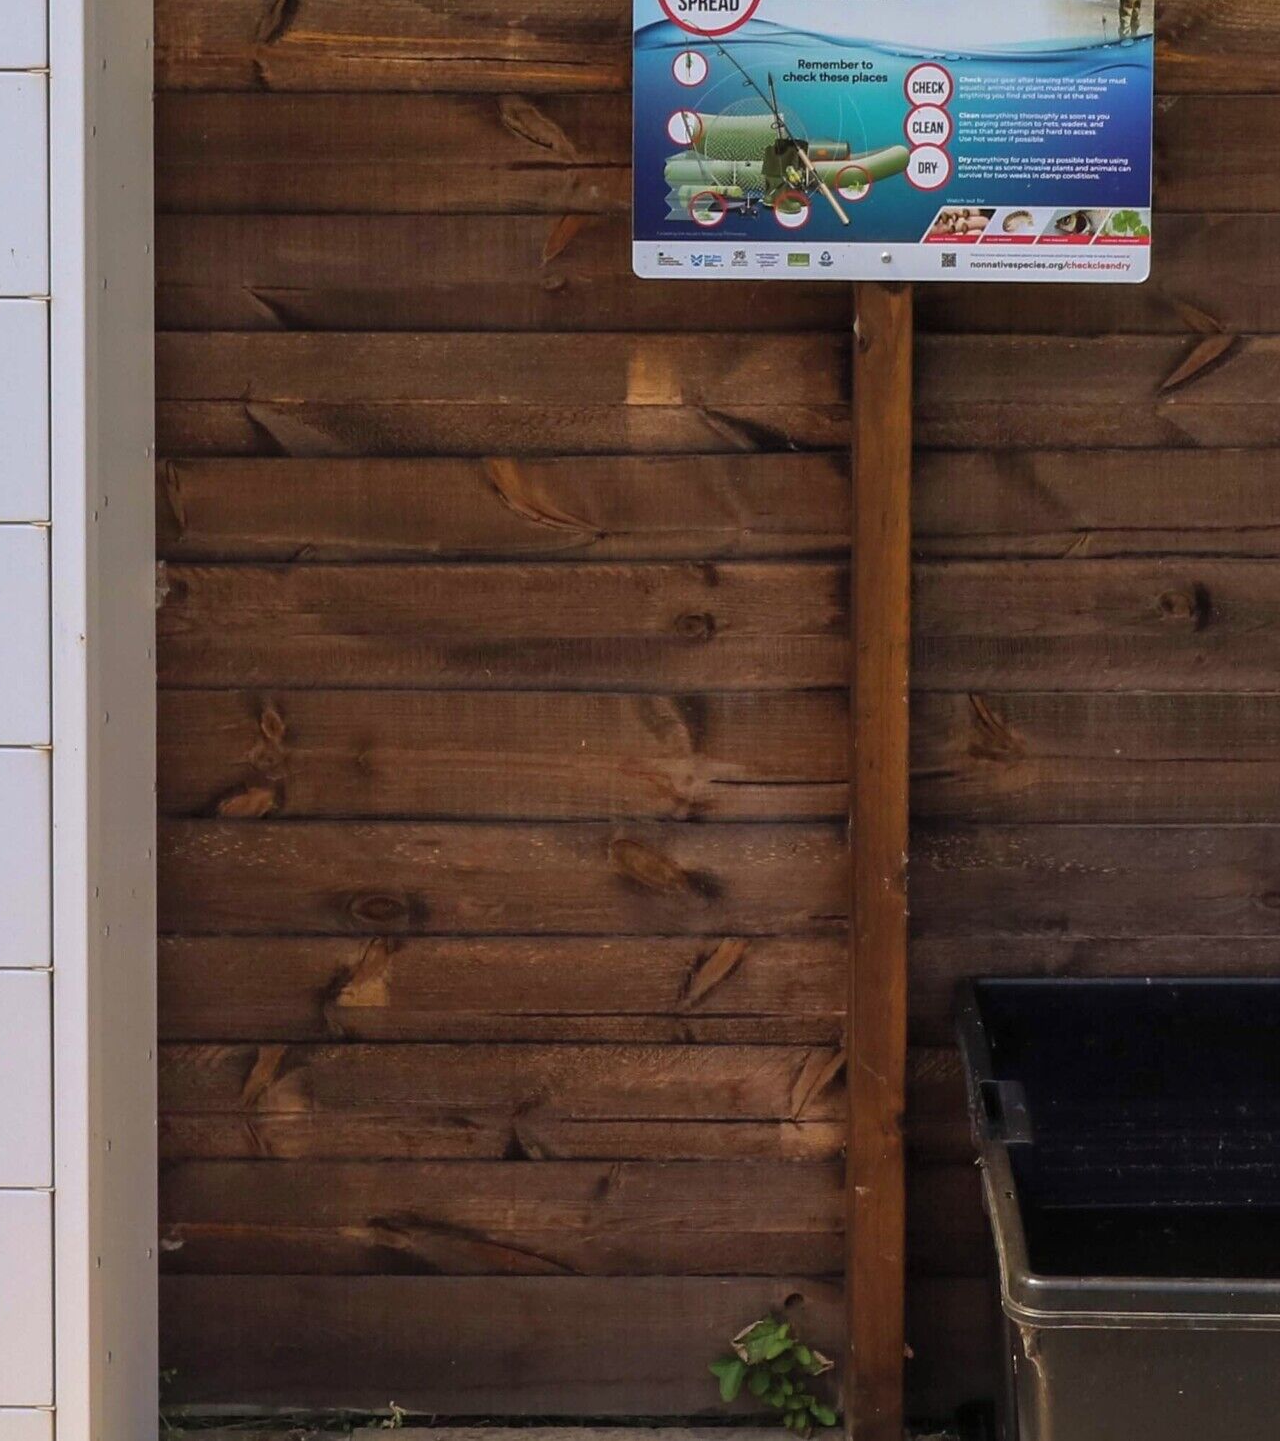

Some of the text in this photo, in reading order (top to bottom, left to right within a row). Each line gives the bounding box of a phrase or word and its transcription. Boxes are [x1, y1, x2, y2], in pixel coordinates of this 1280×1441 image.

[798, 59, 873, 70] Remember to
[783, 71, 887, 84] check these places
[1036, 77, 1060, 85] leaving
[912, 81, 944, 94] CHECK
[1026, 85, 1044, 93] plant
[960, 92, 990, 101] anything
[981, 113, 1018, 121] everything
[1020, 113, 1058, 121] thoroughly
[912, 121, 943, 134] CLEAN
[975, 120, 997, 129] paying
[1008, 128, 1029, 136] damp
[958, 156, 970, 165] Dry
[973, 157, 1009, 165] everything
[1031, 157, 1045, 165] long
[1056, 157, 1084, 165] possible
[1110, 157, 1128, 166] using
[918, 162, 937, 174] DRY
[1053, 165, 1073, 173] plants
[1041, 173, 1061, 181] damp
[970, 260, 1130, 271] nonnativespecies.org/checkcleandry
